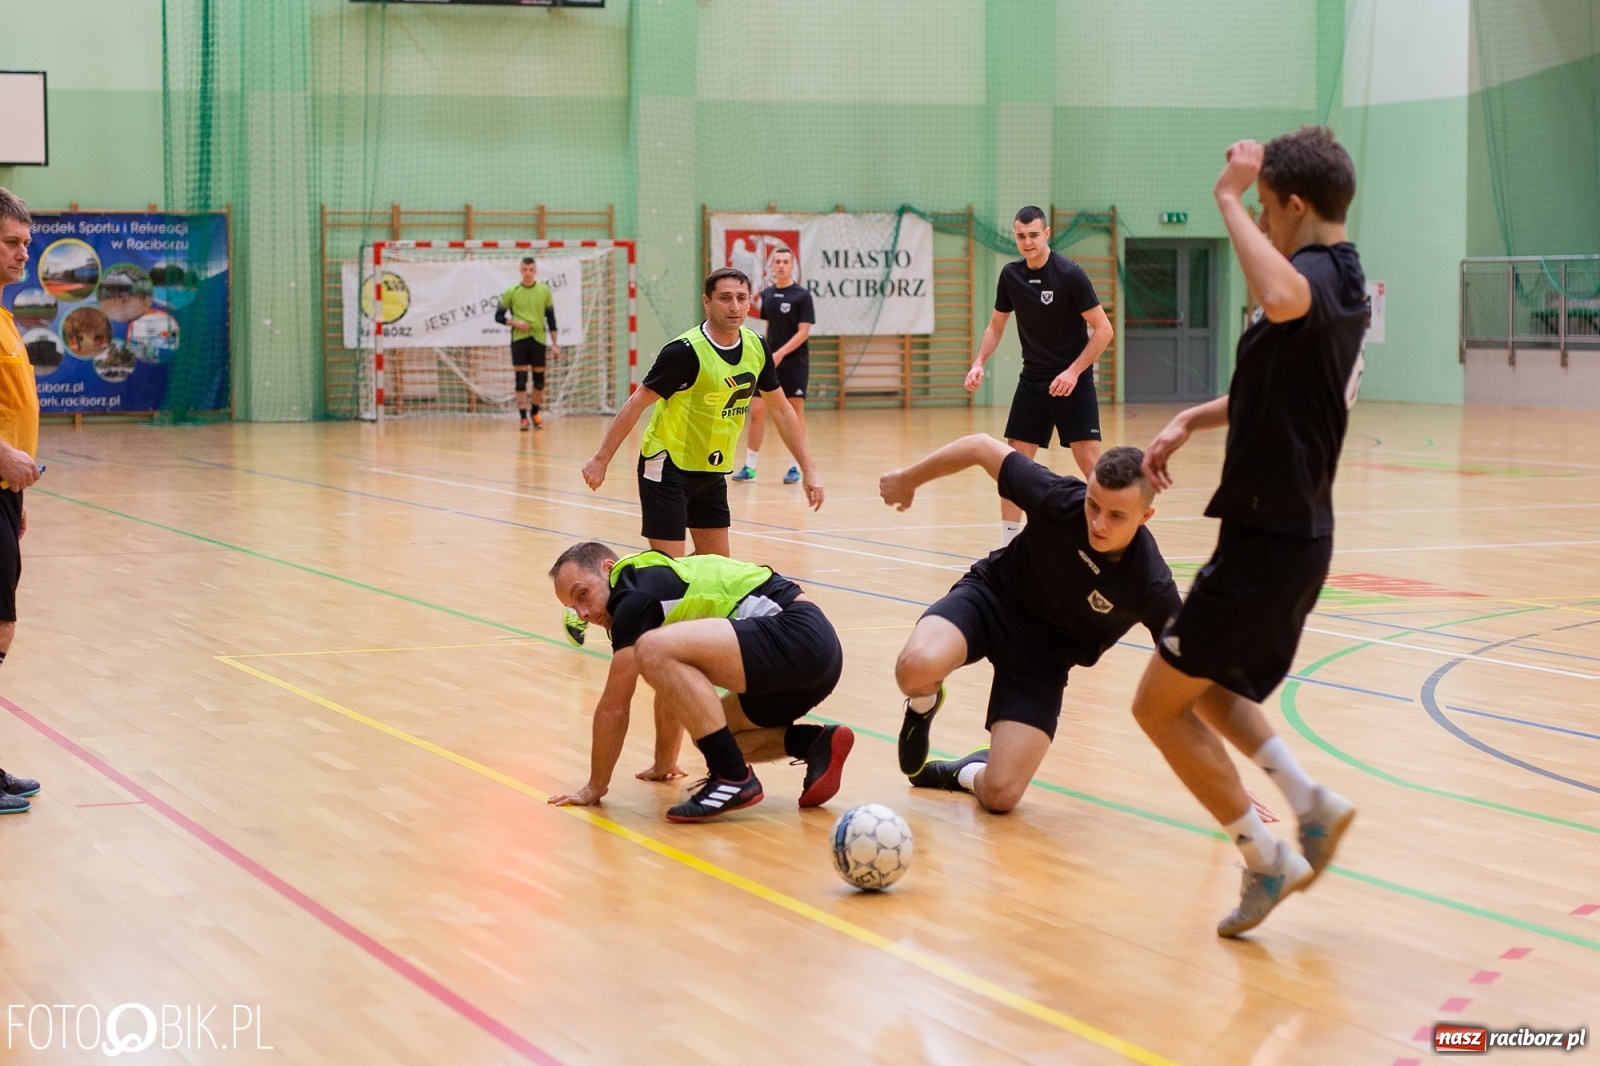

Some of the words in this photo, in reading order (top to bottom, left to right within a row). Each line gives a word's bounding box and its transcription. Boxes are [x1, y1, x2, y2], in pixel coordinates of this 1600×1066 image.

[32, 221, 76, 235] środek
[78, 221, 120, 236] Sportu
[122, 221, 128, 234] i
[130, 221, 189, 237] Rekreacji
[111, 240, 122, 250] w
[126, 238, 190, 251] Raciborzu
[821, 249, 912, 269] MIASTO
[424, 308, 459, 334] JEST
[461, 302, 478, 318] W
[37, 381, 85, 395] ciborz.pl
[39, 394, 121, 408] ark.raciborz.pl
